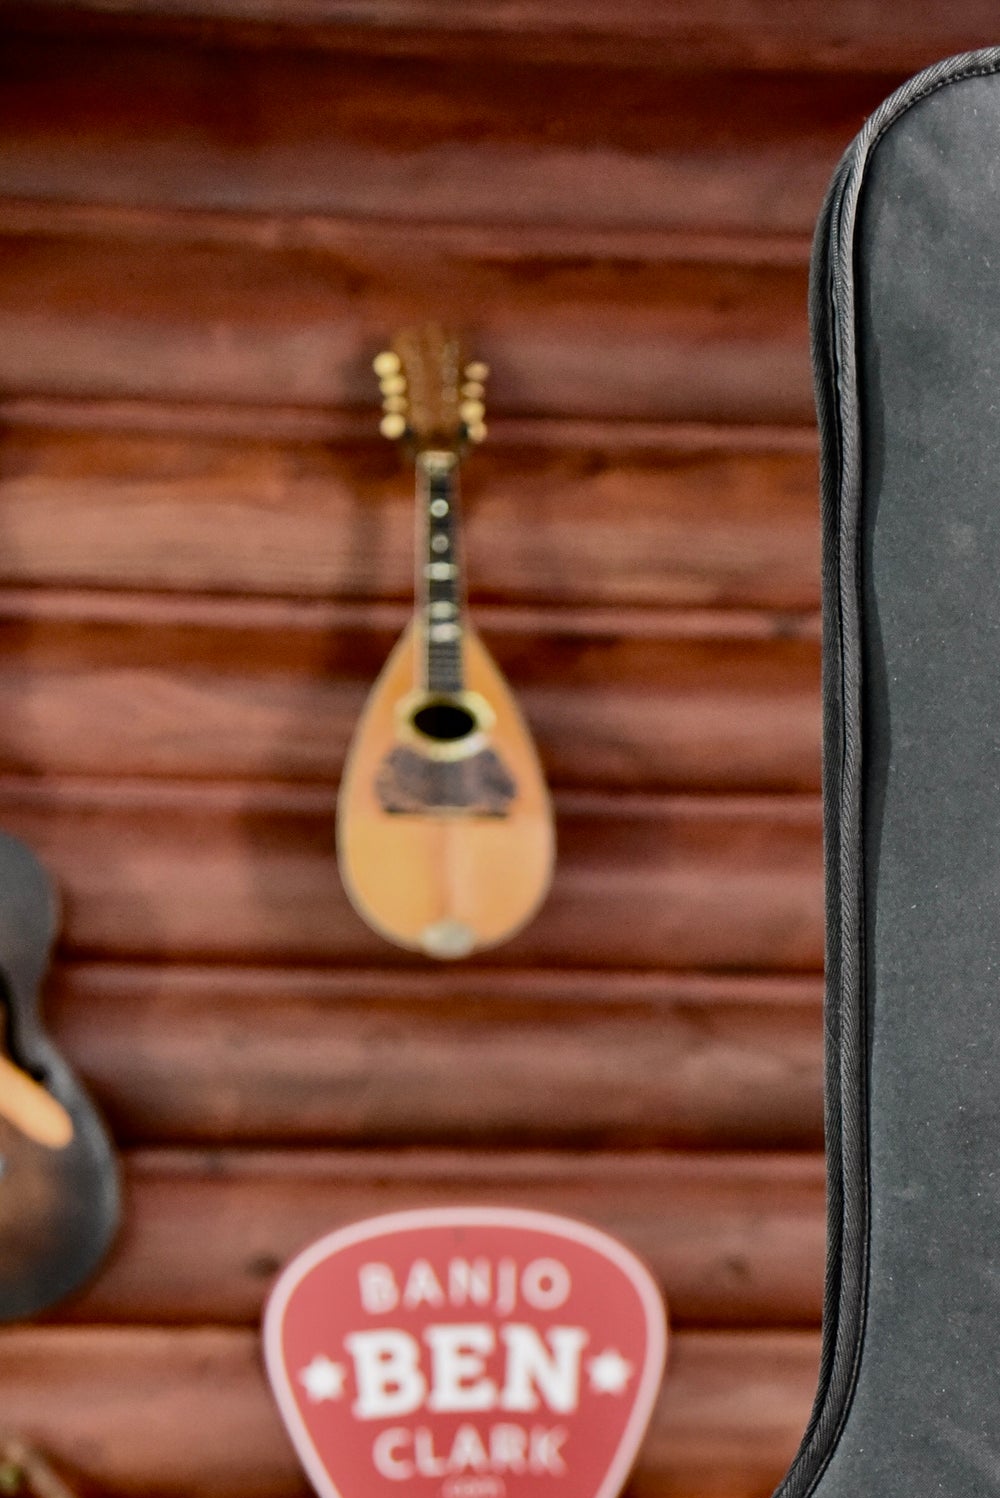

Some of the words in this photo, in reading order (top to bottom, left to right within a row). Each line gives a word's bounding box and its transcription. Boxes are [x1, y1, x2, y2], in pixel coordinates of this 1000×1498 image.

[358, 1257, 571, 1314] BANJO
[345, 1323, 587, 1419] BEN
[373, 1423, 566, 1479] CLARK
